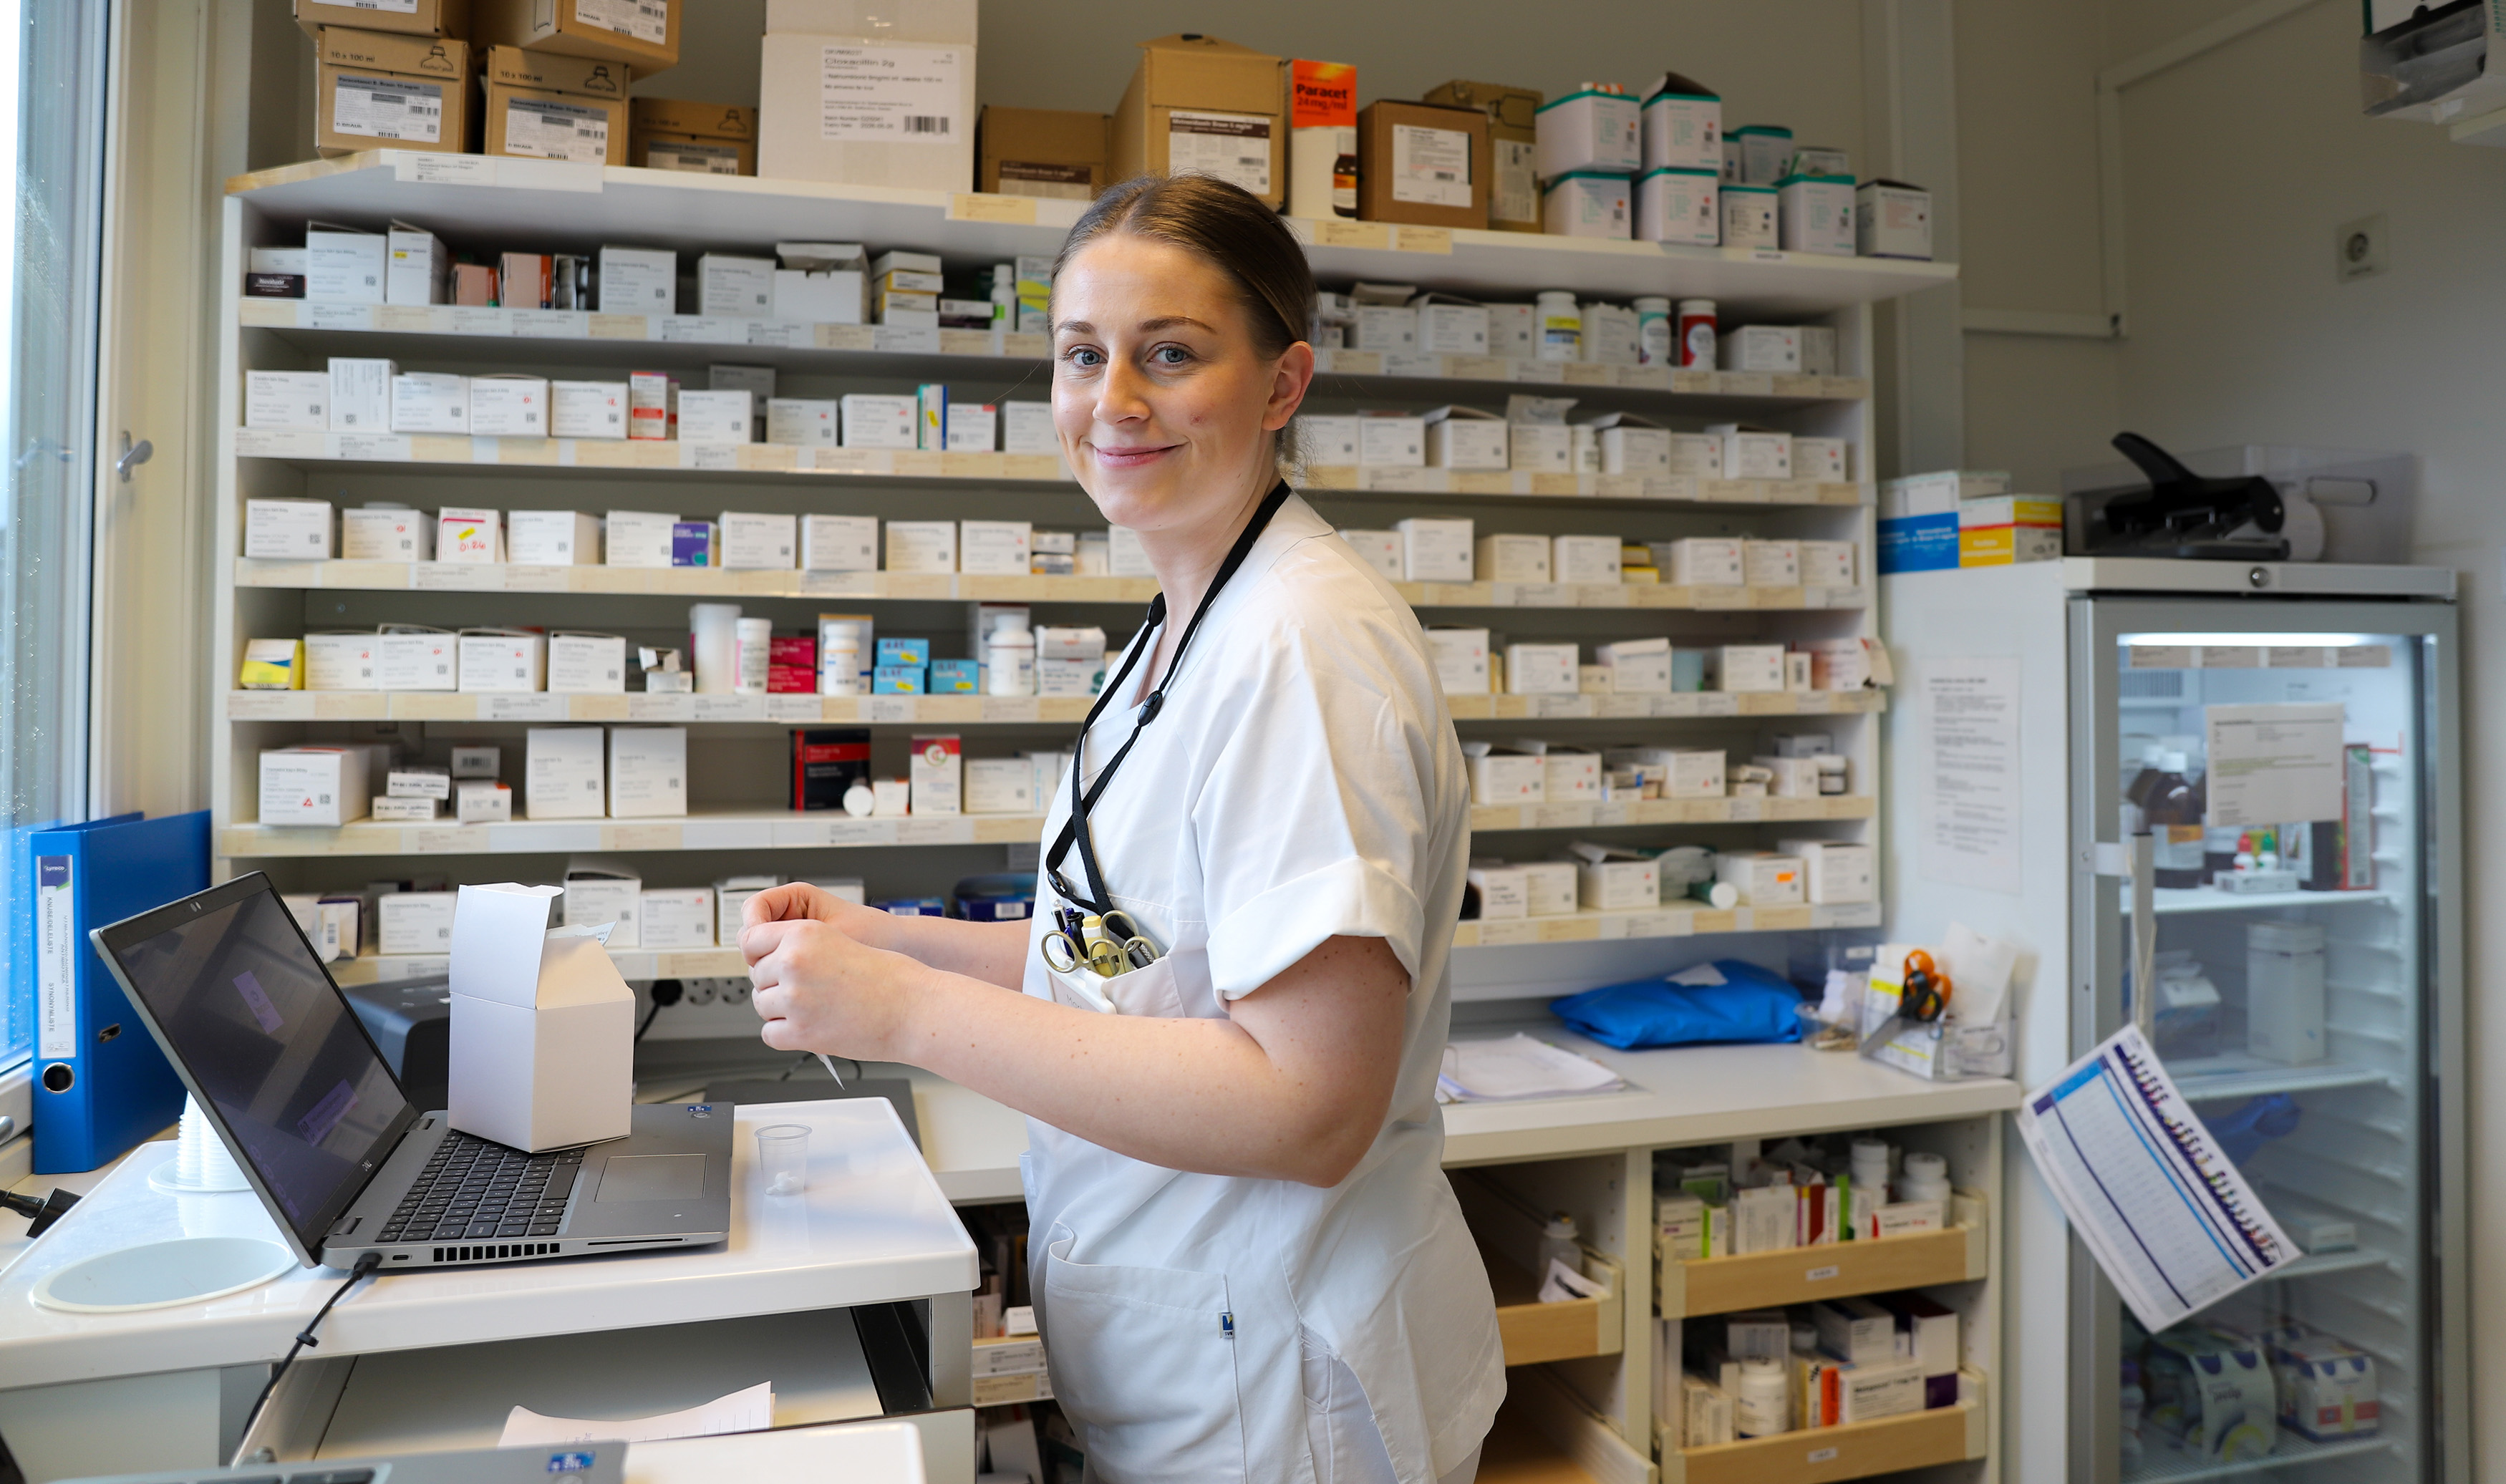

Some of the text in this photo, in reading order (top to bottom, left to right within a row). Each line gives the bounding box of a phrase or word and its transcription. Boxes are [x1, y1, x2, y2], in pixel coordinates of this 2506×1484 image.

[825, 57, 895, 68] Cloxacillin 2g
[1296, 83, 1348, 100] Paracet
